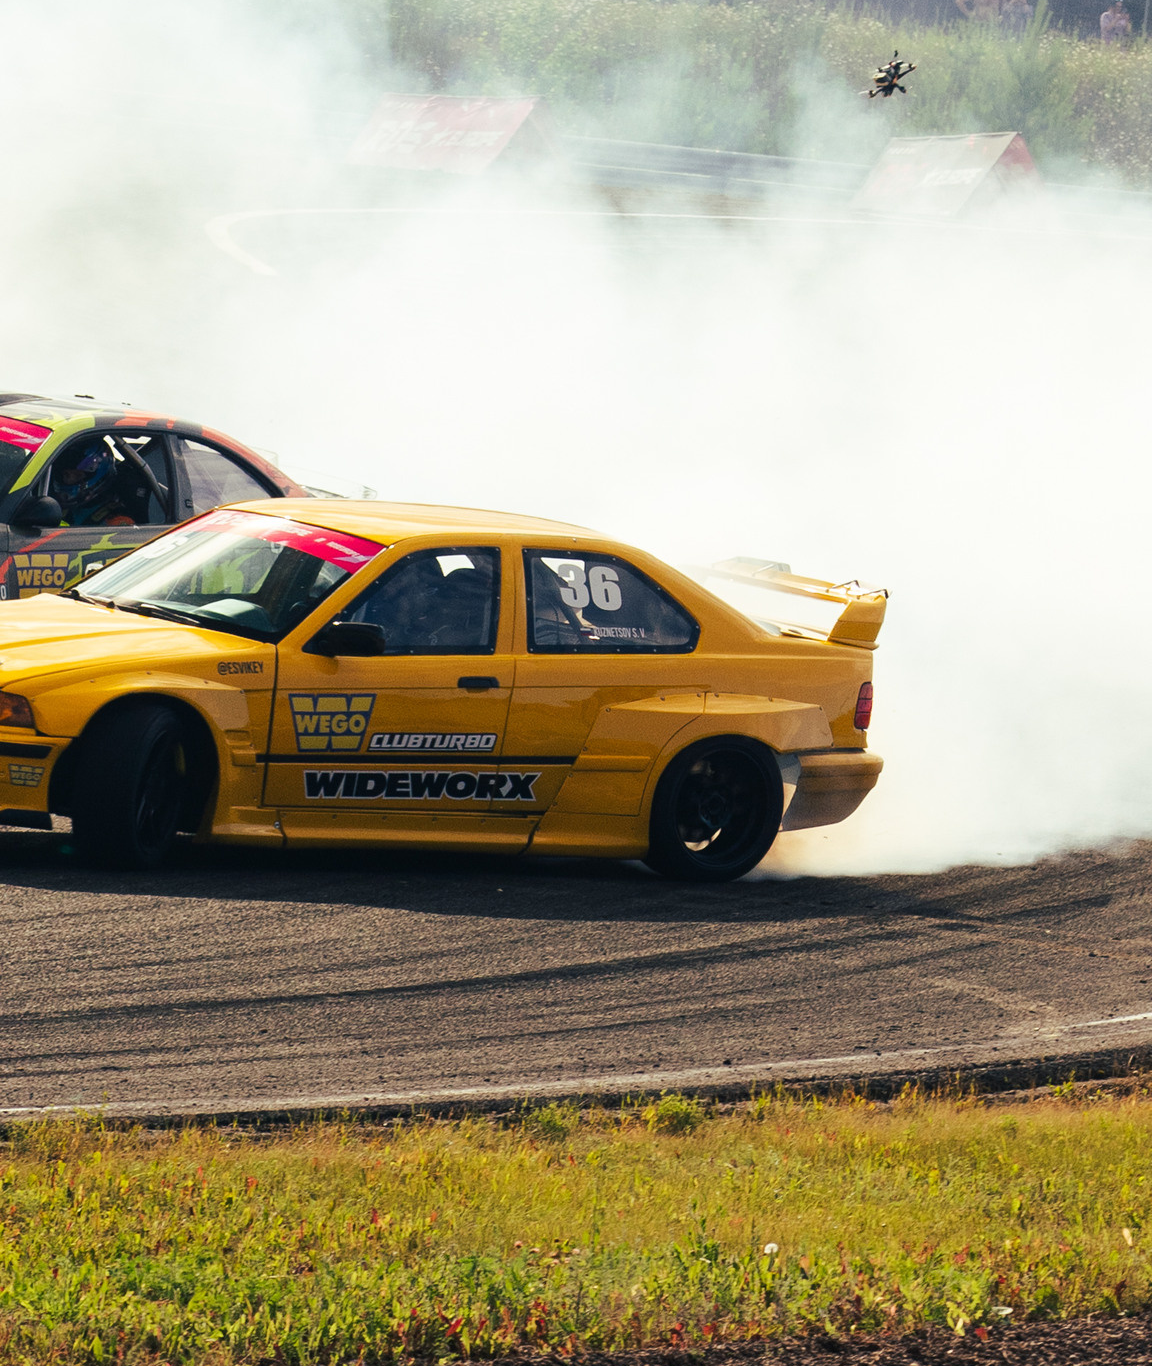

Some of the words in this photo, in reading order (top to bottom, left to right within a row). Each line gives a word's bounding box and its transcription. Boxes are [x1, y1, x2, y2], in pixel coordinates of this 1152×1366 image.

[17, 568, 66, 586] WEGO
[558, 563, 622, 611] 36
[217, 661, 264, 676] @ESVIKEY
[294, 713, 367, 734] WEGO
[10, 772, 41, 782] WEGO
[303, 770, 543, 801] WIDEWORX
